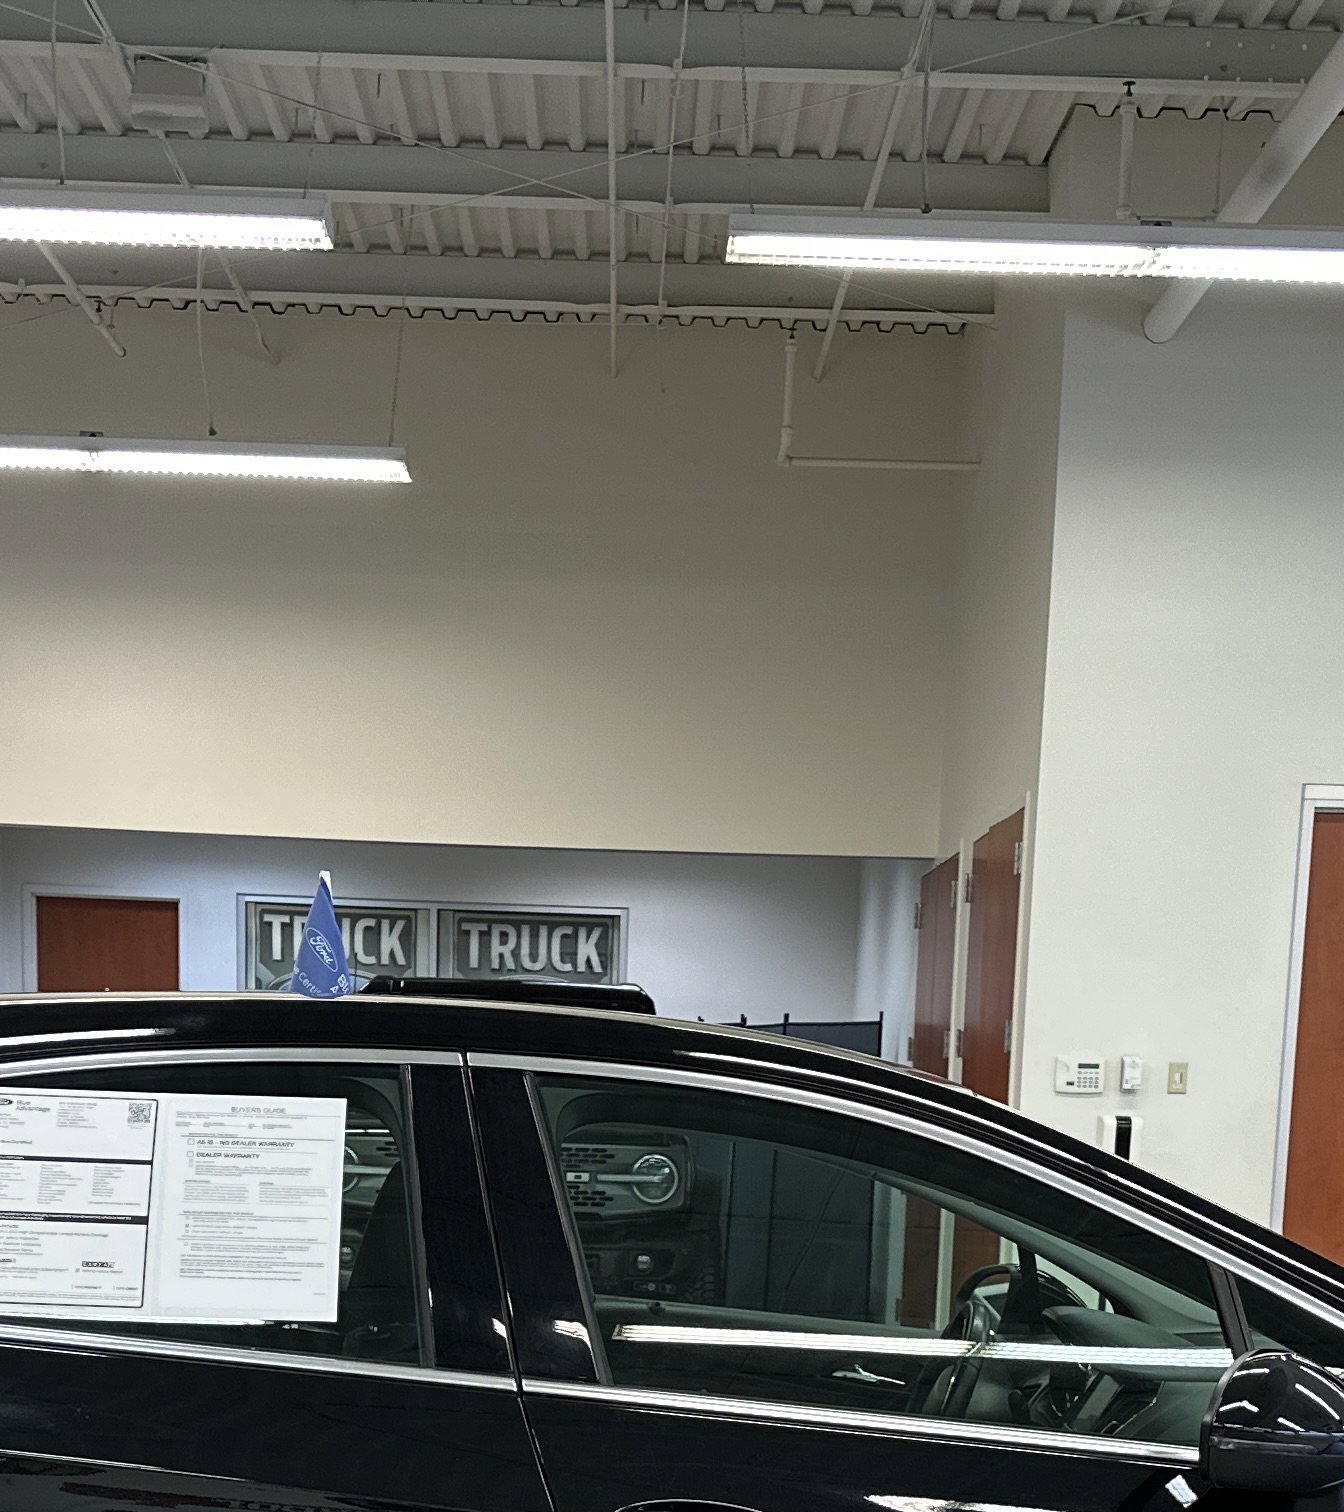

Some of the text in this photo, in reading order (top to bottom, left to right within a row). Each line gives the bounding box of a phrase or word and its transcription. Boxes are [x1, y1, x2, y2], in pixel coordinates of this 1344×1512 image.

[262, 914, 407, 966] TCK
[309, 935, 334, 965] Ford
[460, 922, 604, 973] TRUCK
